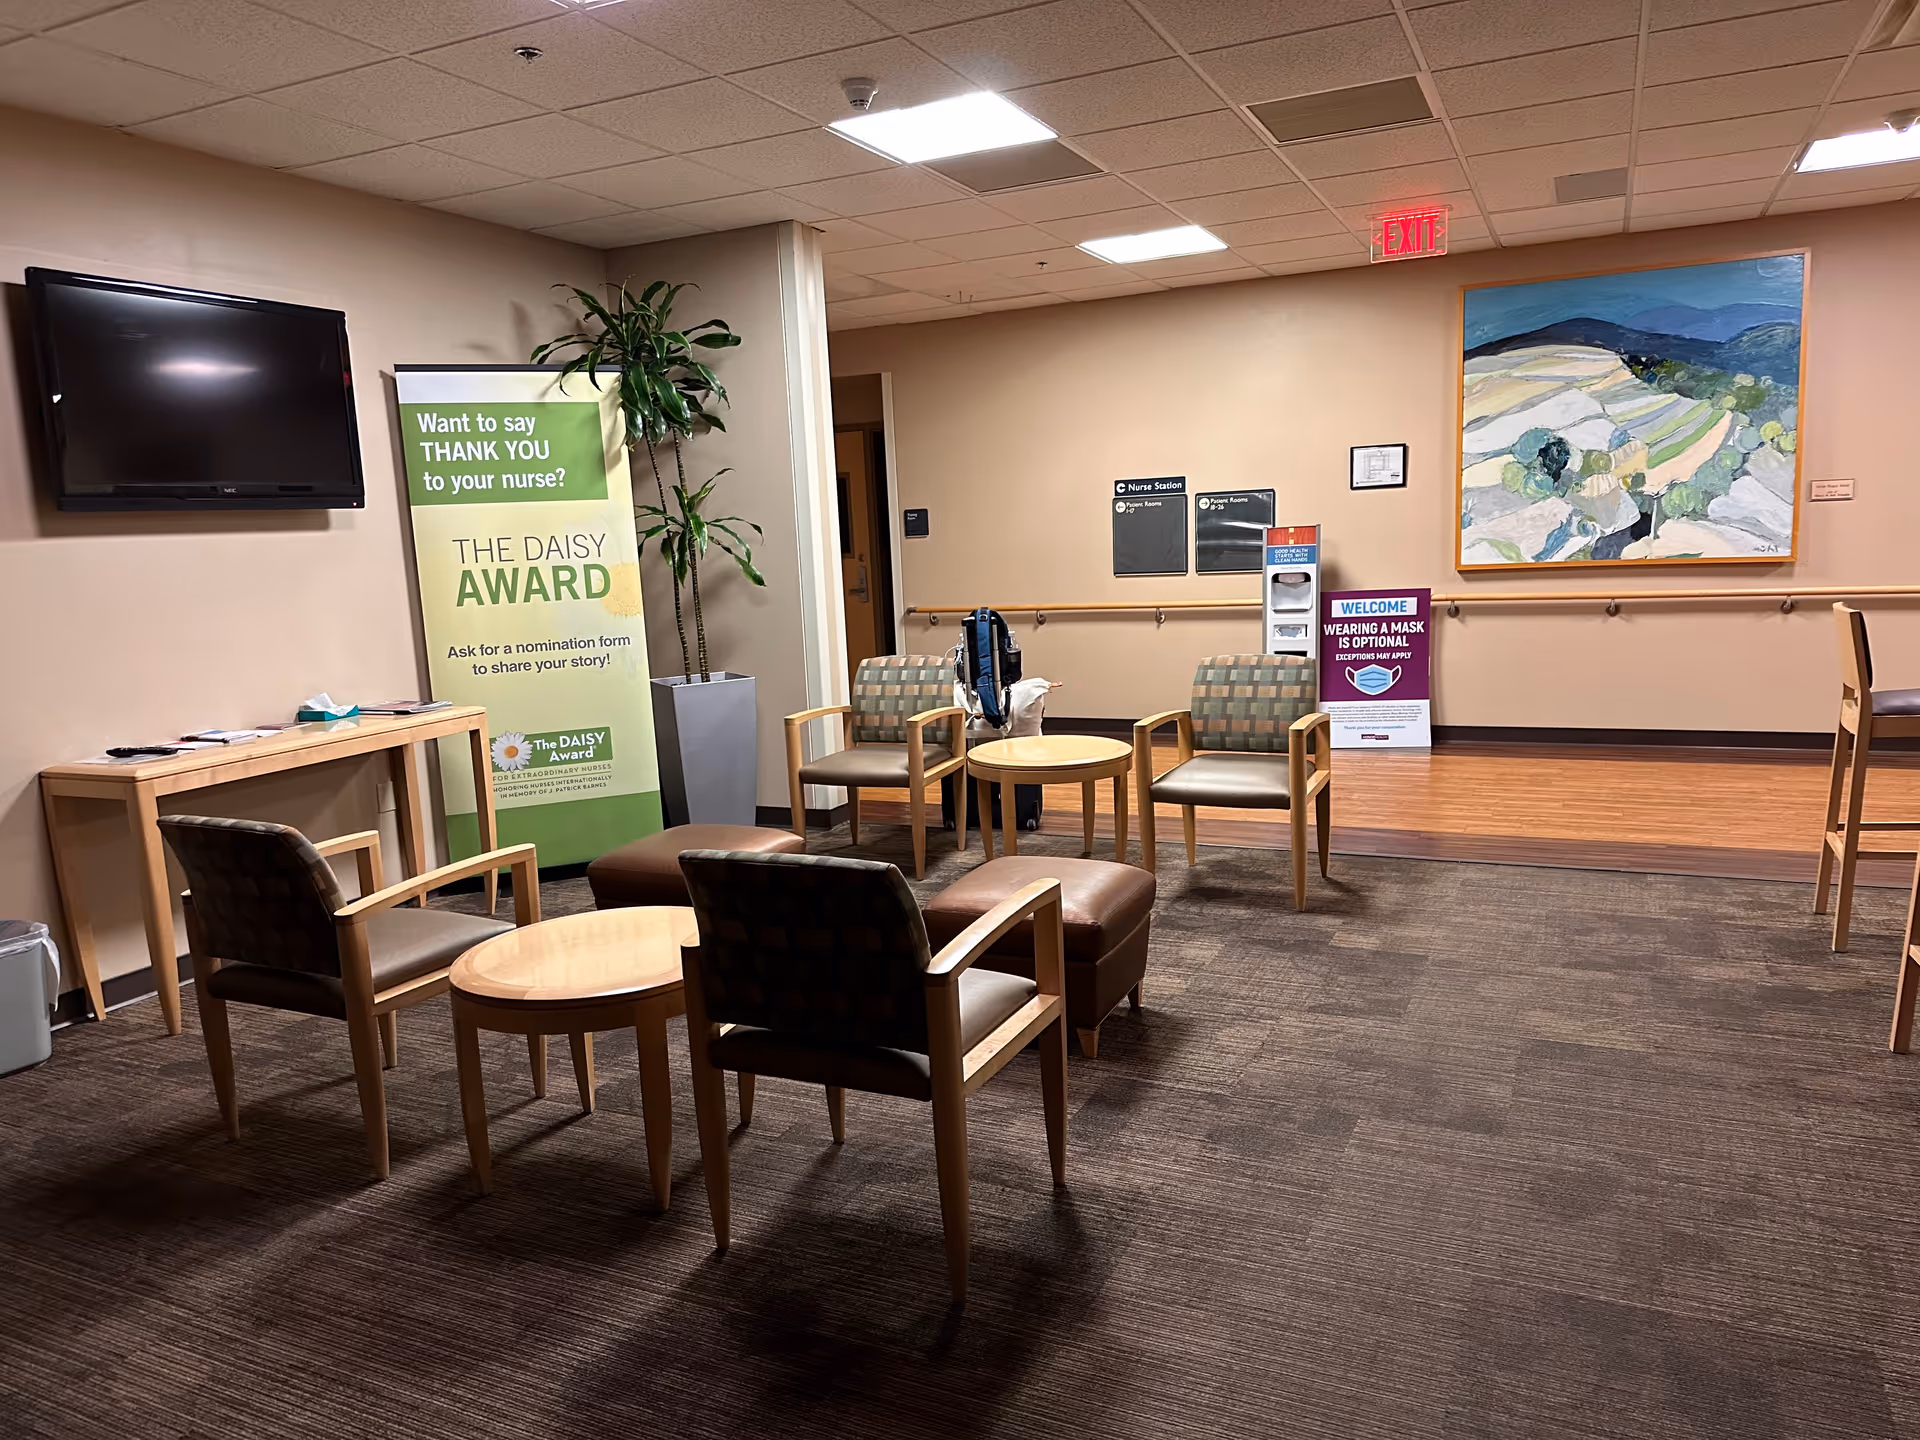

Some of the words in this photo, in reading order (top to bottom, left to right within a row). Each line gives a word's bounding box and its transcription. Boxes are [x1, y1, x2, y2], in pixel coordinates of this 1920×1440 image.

[1382, 212, 1440, 256] EXIT
[417, 412, 471, 433] Want
[477, 413, 497, 432] to
[504, 416, 536, 436] say
[420, 441, 499, 462] THANK
[504, 440, 550, 460] YOU
[424, 472, 444, 491] to
[451, 473, 494, 494] your
[502, 468, 565, 489] nurse?
[1128, 483, 1152, 492] Nurse
[1154, 481, 1182, 490] Station
[452, 537, 515, 564] THE
[524, 533, 606, 561] DAISY
[456, 563, 611, 607] AWARD
[1341, 600, 1407, 614] WELCOME
[1323, 622, 1378, 636] WEARING
[1380, 622, 1388, 634] A
[1391, 621, 1424, 634] MASK
[447, 645, 477, 659] Ask
[479, 643, 500, 656] for
[503, 646, 512, 654] a
[516, 637, 596, 653] nomination
[599, 635, 631, 647] form
[1339, 637, 1350, 649] IS
[1352, 635, 1409, 648] OPTIONAL
[472, 663, 487, 675] to
[491, 661, 532, 674] share
[535, 658, 567, 673] your
[571, 653, 610, 668] story!
[1335, 652, 1375, 661] EXCEPTIONS
[1376, 652, 1391, 660] MAY
[1391, 651, 1412, 660] APPLY
[533, 738, 557, 751] The
[559, 731, 606, 748] DAISY
[492, 774, 509, 782] FOR
[511, 767, 579, 780] EXTRAORDINARY
[581, 763, 612, 772] NURSES
[492, 784, 529, 793] HONORING
[530, 781, 555, 789] NURSES
[556, 775, 612, 786] INTERNATIONALLY
[508, 790, 537, 798] MEMORY
[555, 785, 582, 793] PATRICK
